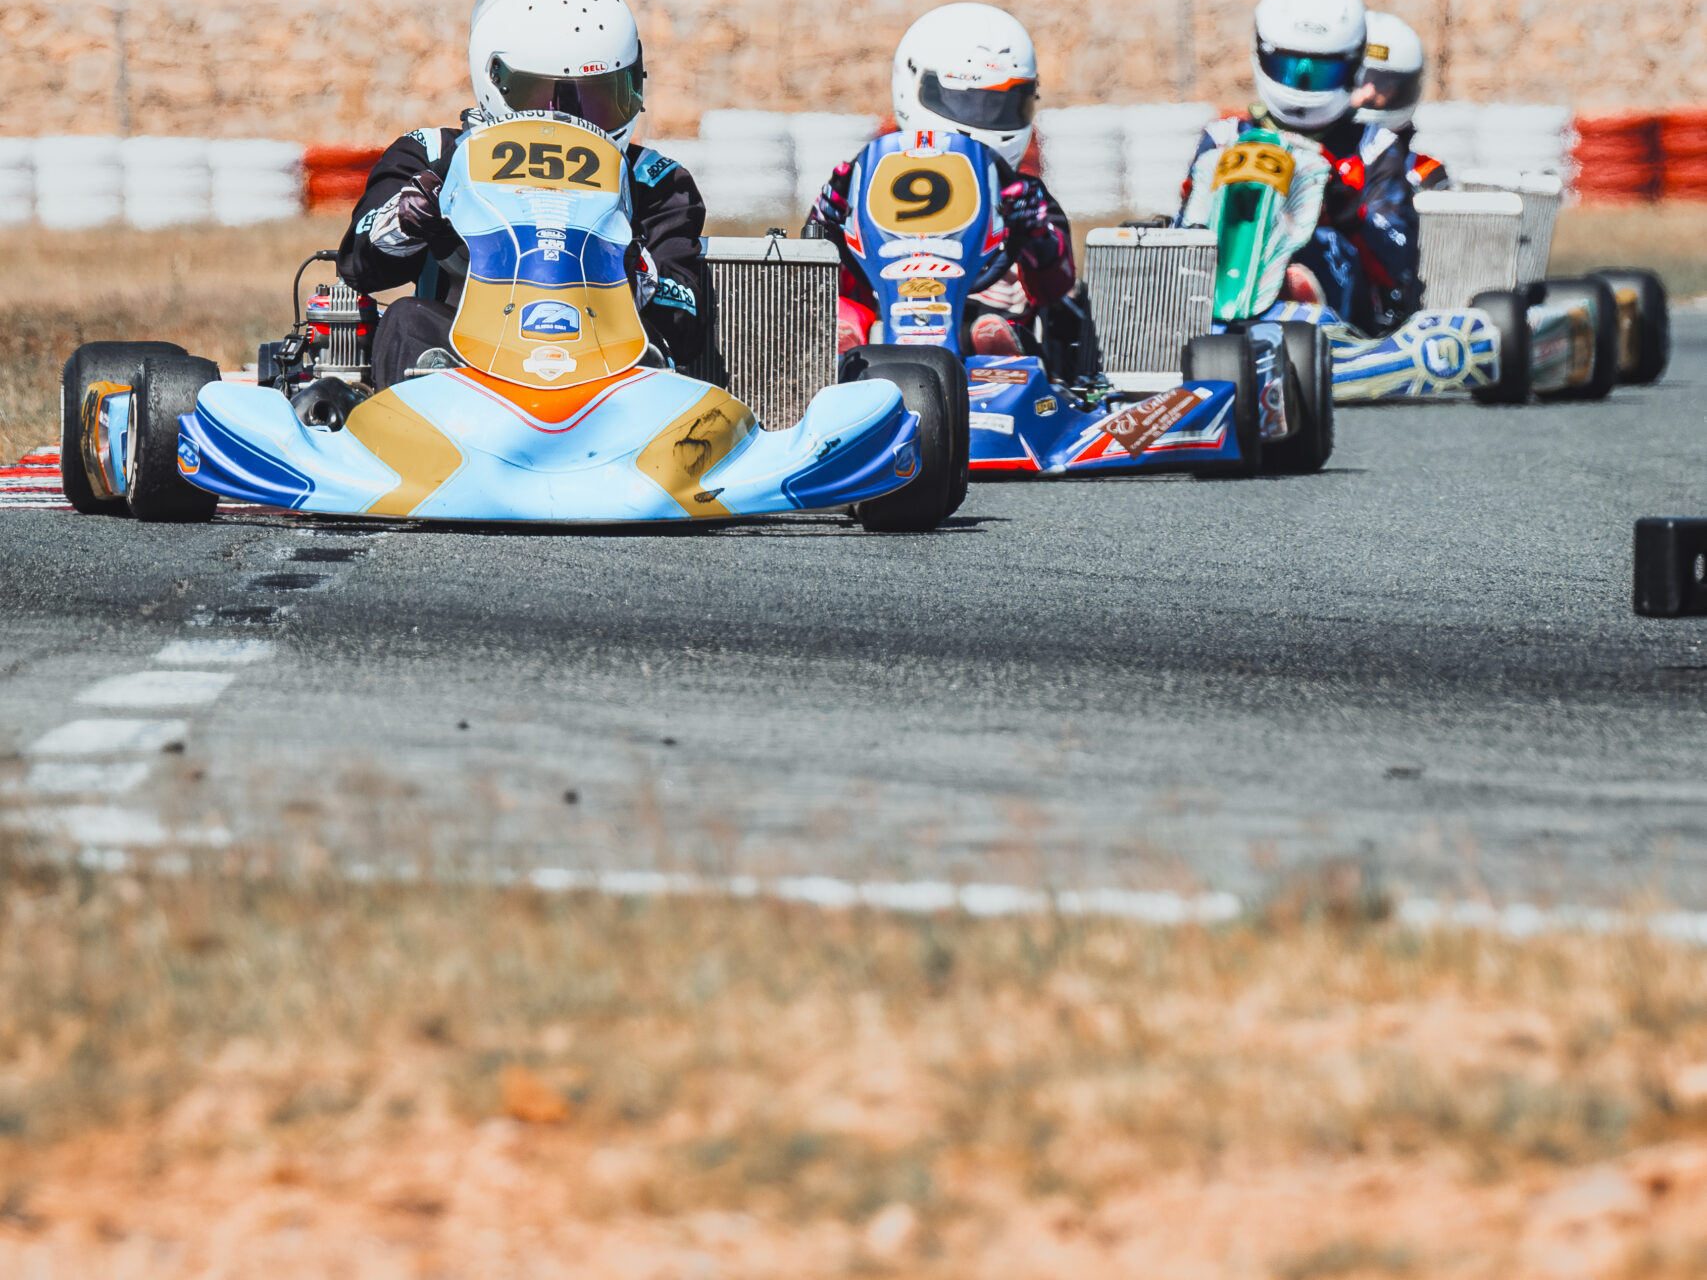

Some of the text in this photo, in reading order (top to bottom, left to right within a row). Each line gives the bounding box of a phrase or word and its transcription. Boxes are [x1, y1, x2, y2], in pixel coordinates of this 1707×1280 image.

[583, 63, 606, 72] BELL
[492, 141, 601, 188] 252
[891, 169, 952, 222] 9
